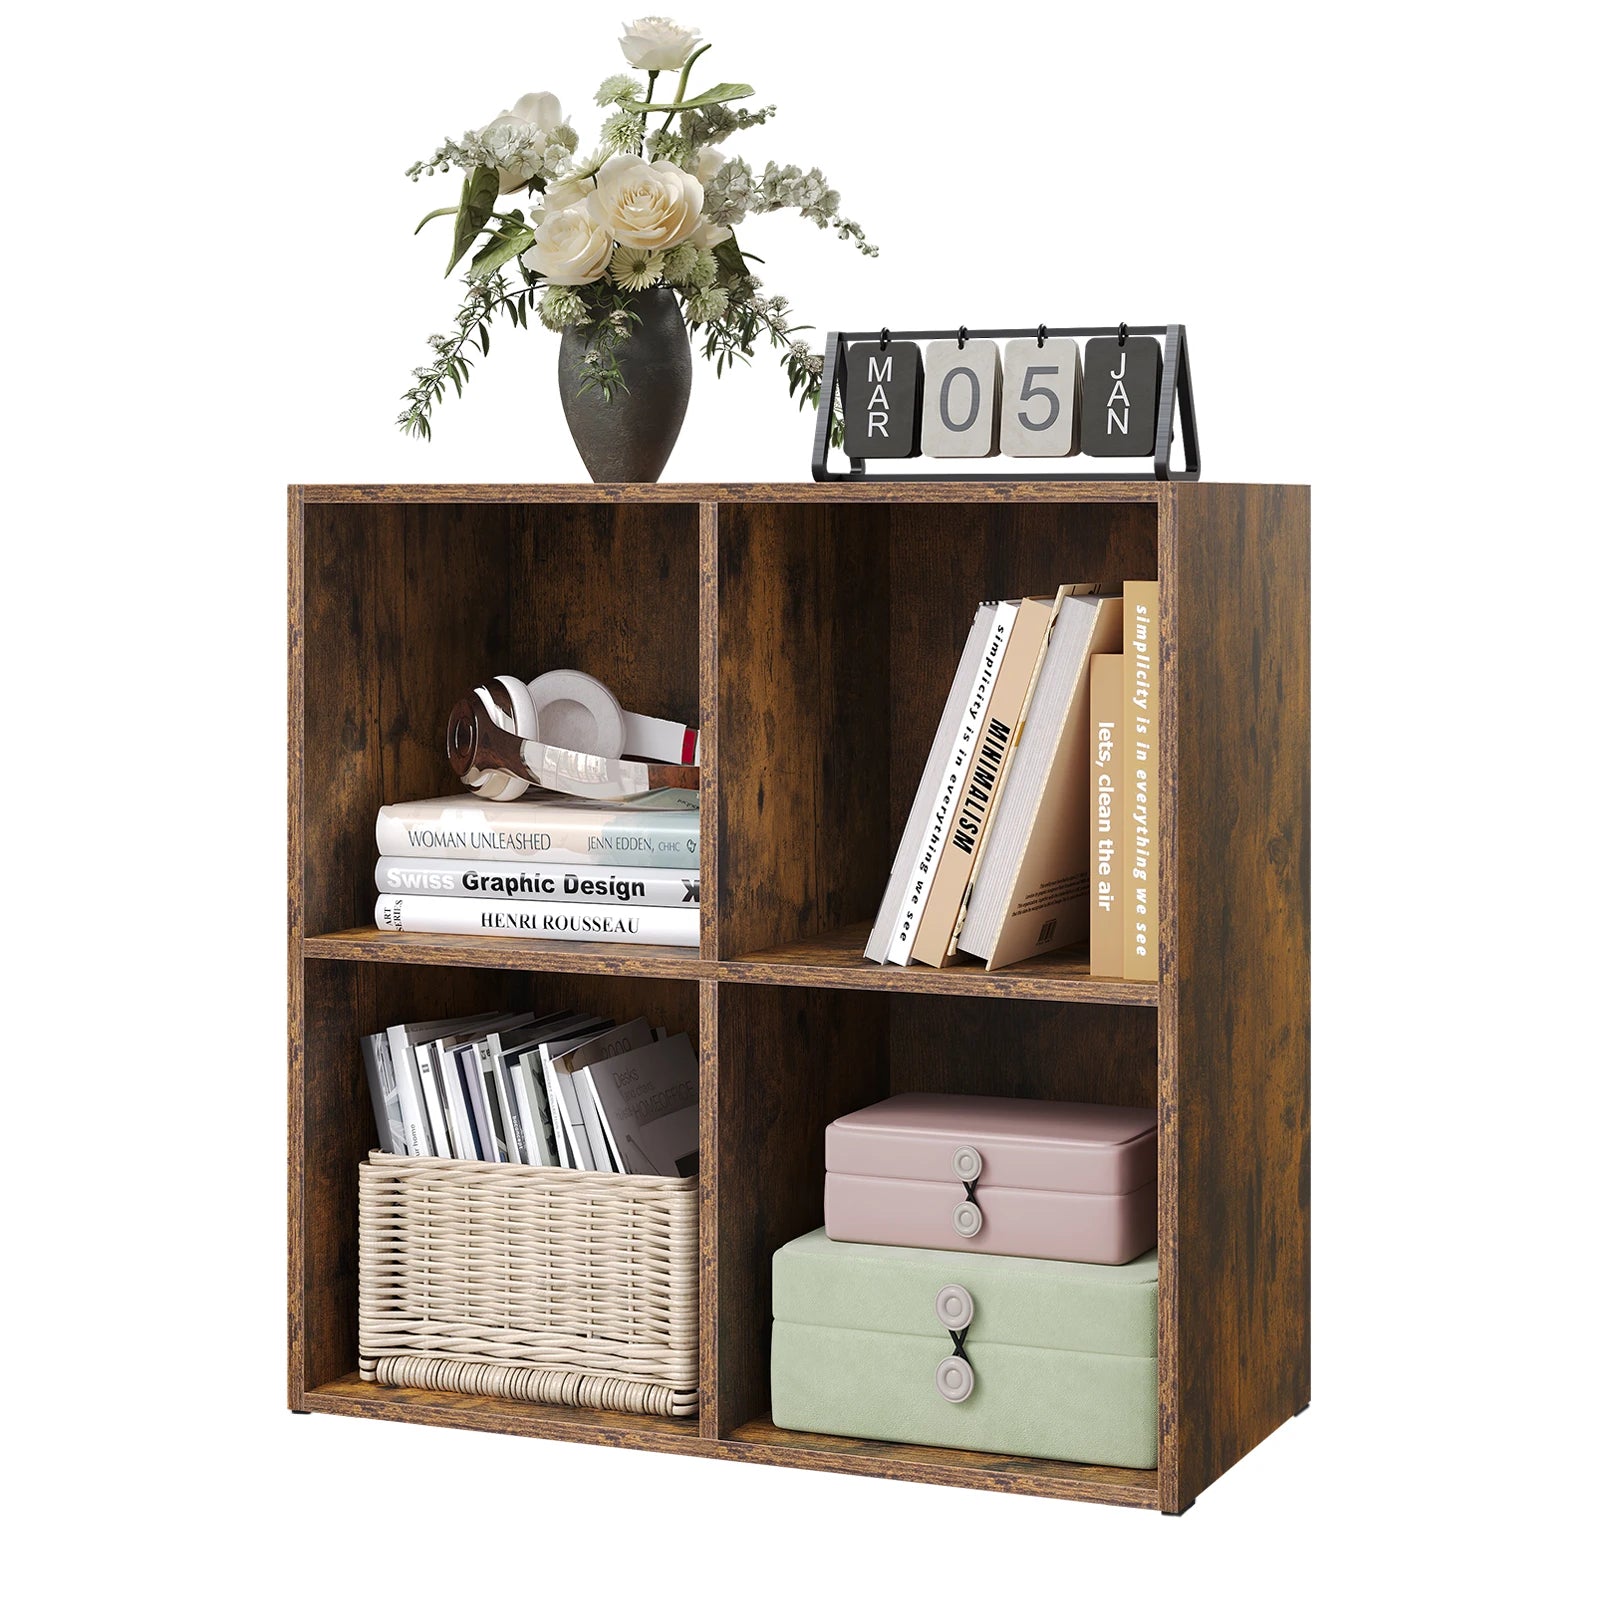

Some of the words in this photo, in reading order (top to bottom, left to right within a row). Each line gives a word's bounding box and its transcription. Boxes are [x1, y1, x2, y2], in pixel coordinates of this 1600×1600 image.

[867, 356, 893, 438] MAR
[1106, 352, 1130, 435] JAN
[969, 624, 1004, 720] simplicity
[1133, 604, 1150, 710] simplicity
[963, 726, 974, 742] is
[1136, 716, 1150, 734] is
[955, 749, 967, 767] in
[1095, 722, 1115, 768] lets,
[1136, 742, 1150, 761] in
[952, 718, 1011, 855] MINIMALISM
[1098, 774, 1115, 833] clean
[919, 773, 957, 874] everything
[1133, 769, 1150, 881] everything
[408, 830, 467, 848] WOMAN
[470, 832, 551, 851] UNLEASHED
[587, 835, 613, 851] JENN
[616, 836, 655, 853] EDDEN,
[1098, 838, 1115, 876] the
[386, 867, 455, 890] Swiss
[462, 870, 555, 896] Graphic
[564, 873, 646, 901] Design
[911, 881, 924, 905] we
[1098, 881, 1115, 912] air
[384, 907, 394, 927] ART
[393, 899, 405, 932] SERIES
[1136, 888, 1147, 915] we
[481, 912, 537, 930] HENRI
[543, 914, 640, 933] ROUSSEAU
[899, 911, 914, 942] see
[1136, 922, 1147, 957] see
